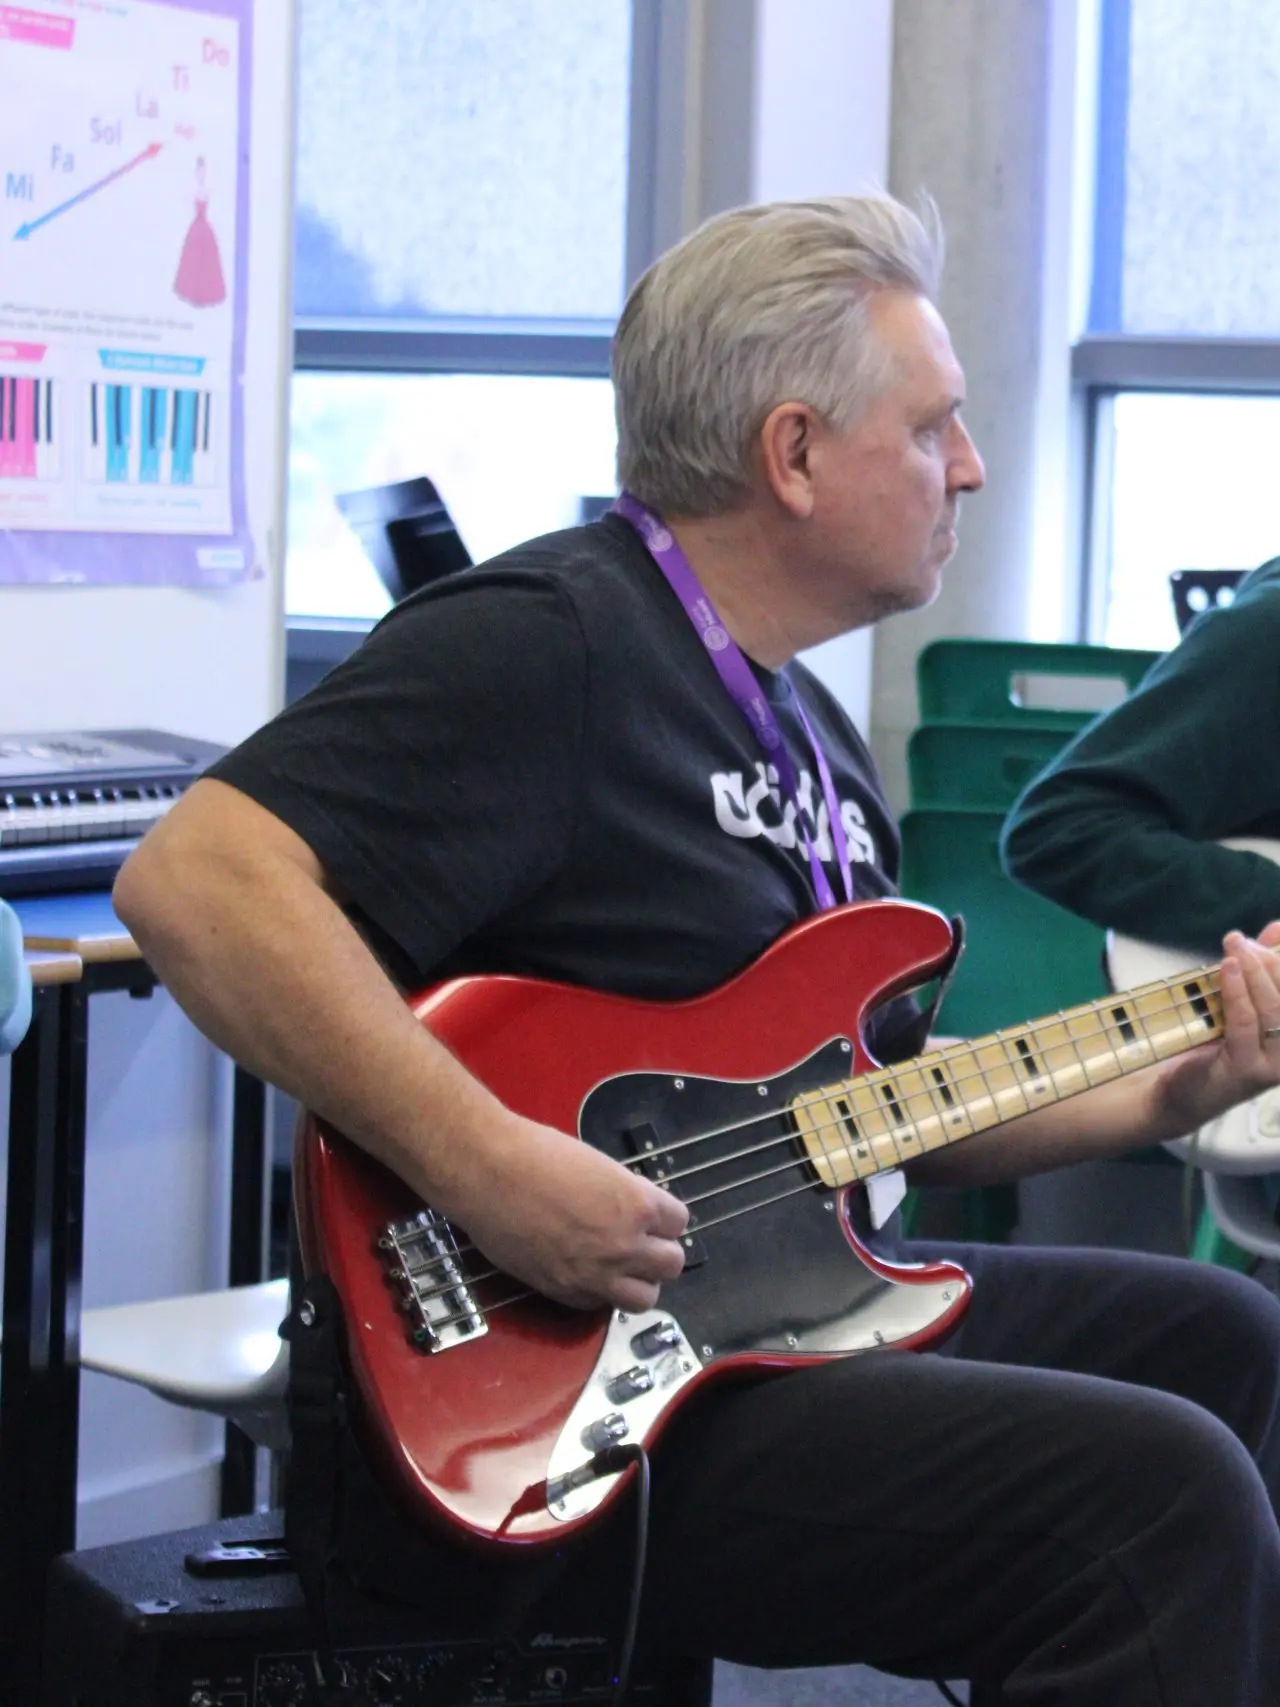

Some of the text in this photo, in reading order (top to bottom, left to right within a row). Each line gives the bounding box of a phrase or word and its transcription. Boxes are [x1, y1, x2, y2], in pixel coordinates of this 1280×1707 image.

[202, 37, 230, 67] Do
[172, 64, 190, 92] Ti
[135, 91, 159, 119] La
[89, 117, 122, 146] Sol
[50, 144, 75, 173] Fa
[5, 172, 34, 201] Mi
